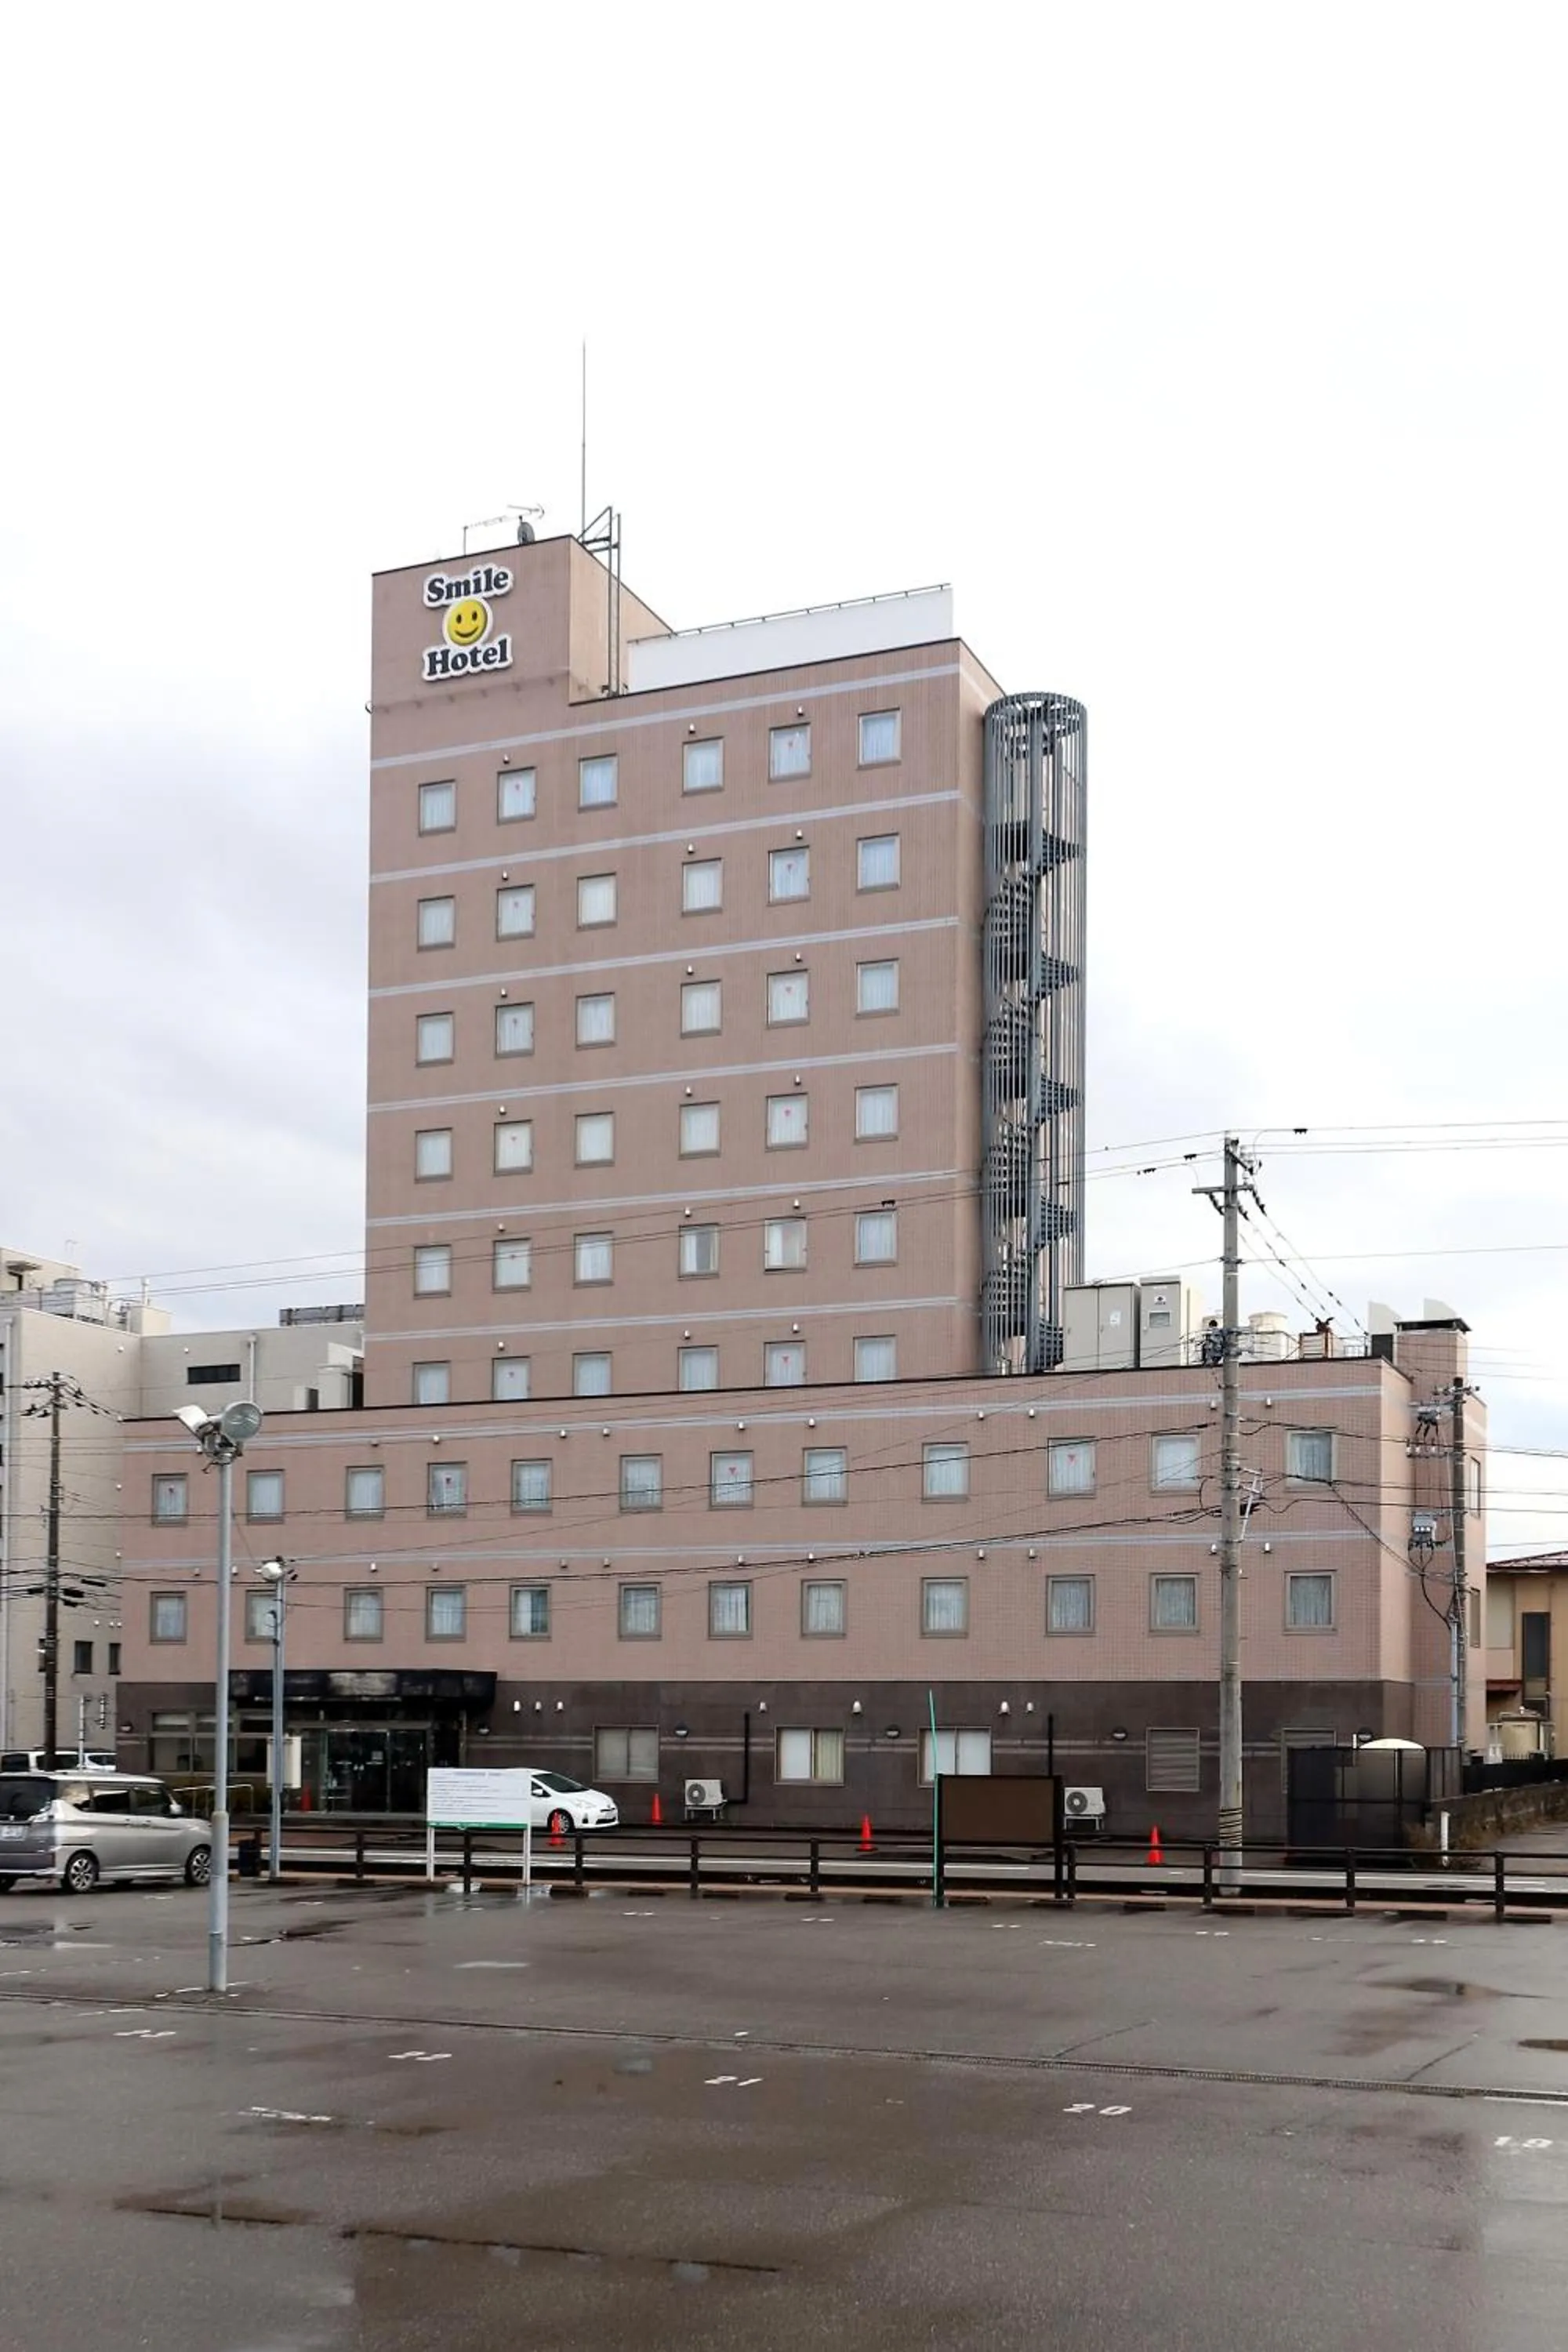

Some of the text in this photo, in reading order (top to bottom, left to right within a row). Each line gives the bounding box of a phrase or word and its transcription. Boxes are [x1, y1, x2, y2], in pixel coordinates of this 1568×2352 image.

[426, 567, 510, 603] Smile
[426, 637, 509, 677] Hotel
[1063, 2103, 1133, 2116] 20
[1494, 2136, 1553, 2149] 19
